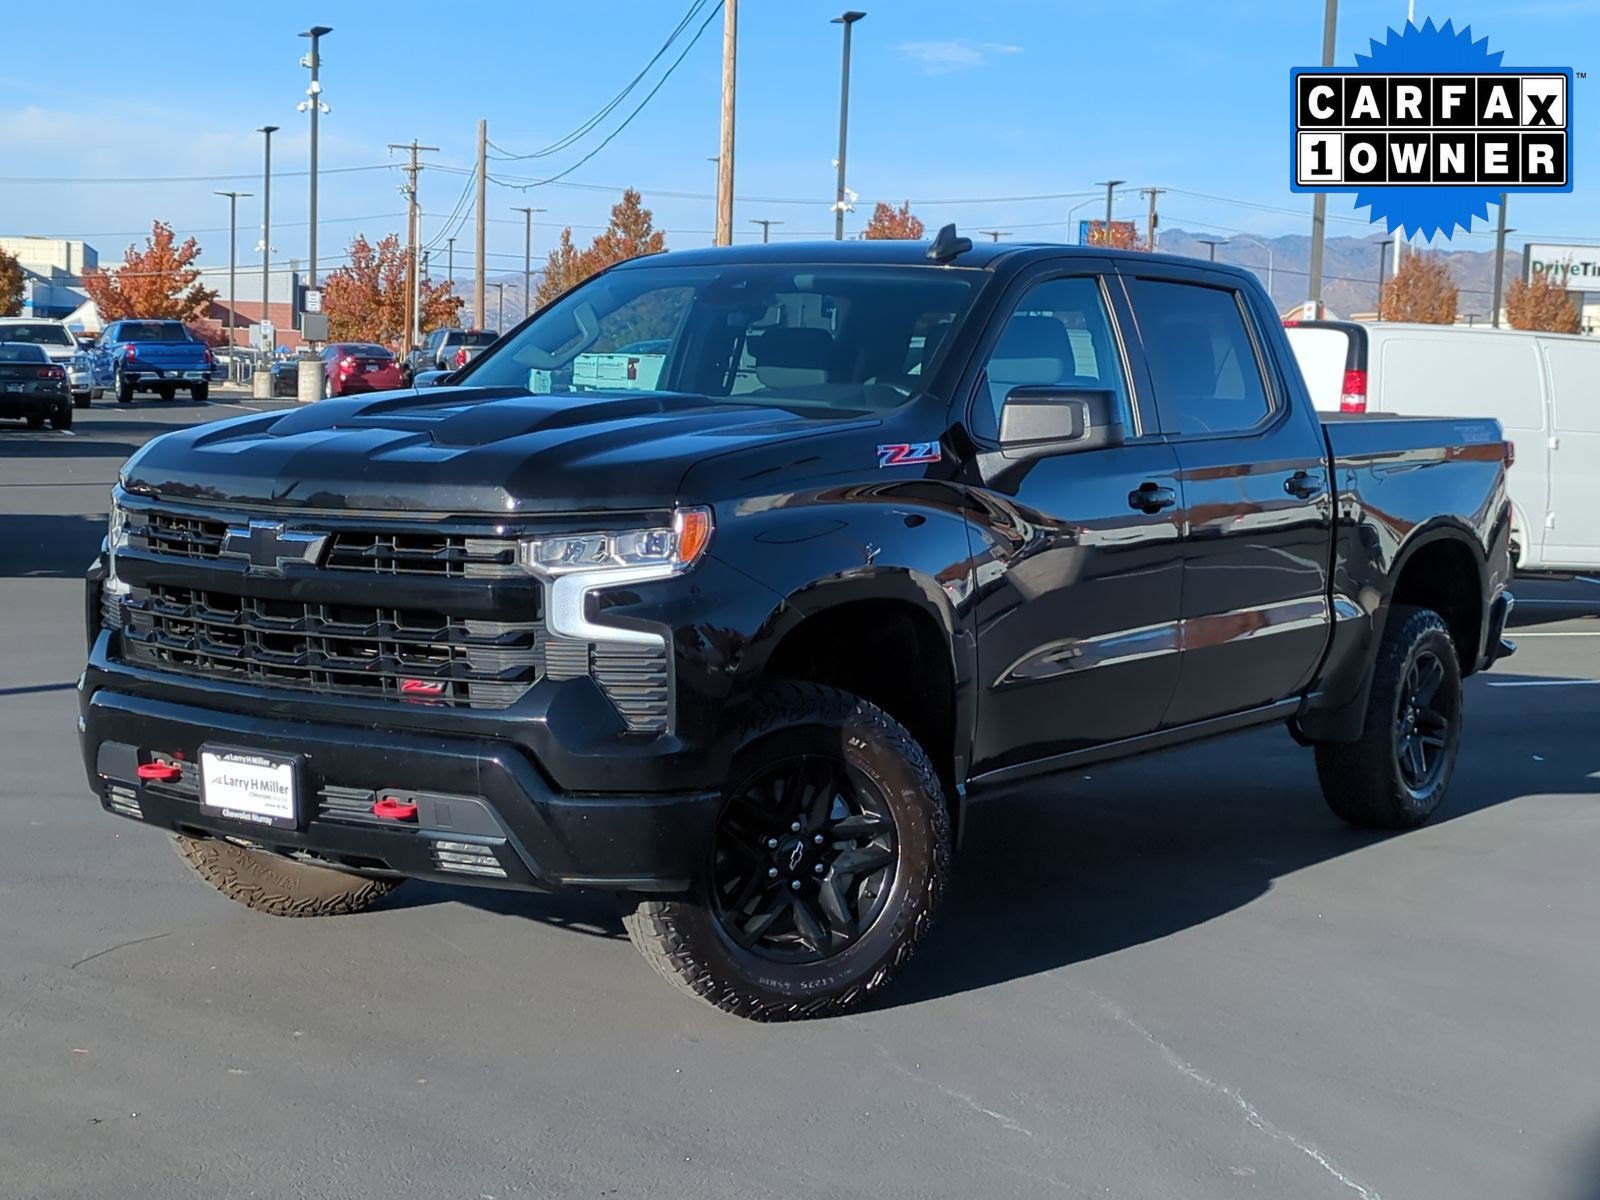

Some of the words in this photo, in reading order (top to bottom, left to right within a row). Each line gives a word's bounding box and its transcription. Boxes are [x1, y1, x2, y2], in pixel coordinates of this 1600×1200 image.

[1532, 260, 1600, 277] DriveTi
[877, 440, 942, 469] Z71
[230, 754, 246, 764] Larry
[252, 757, 270, 766] Miller
[223, 774, 249, 791] Larry
[250, 778, 258, 790] H
[260, 780, 289, 795] Miller
